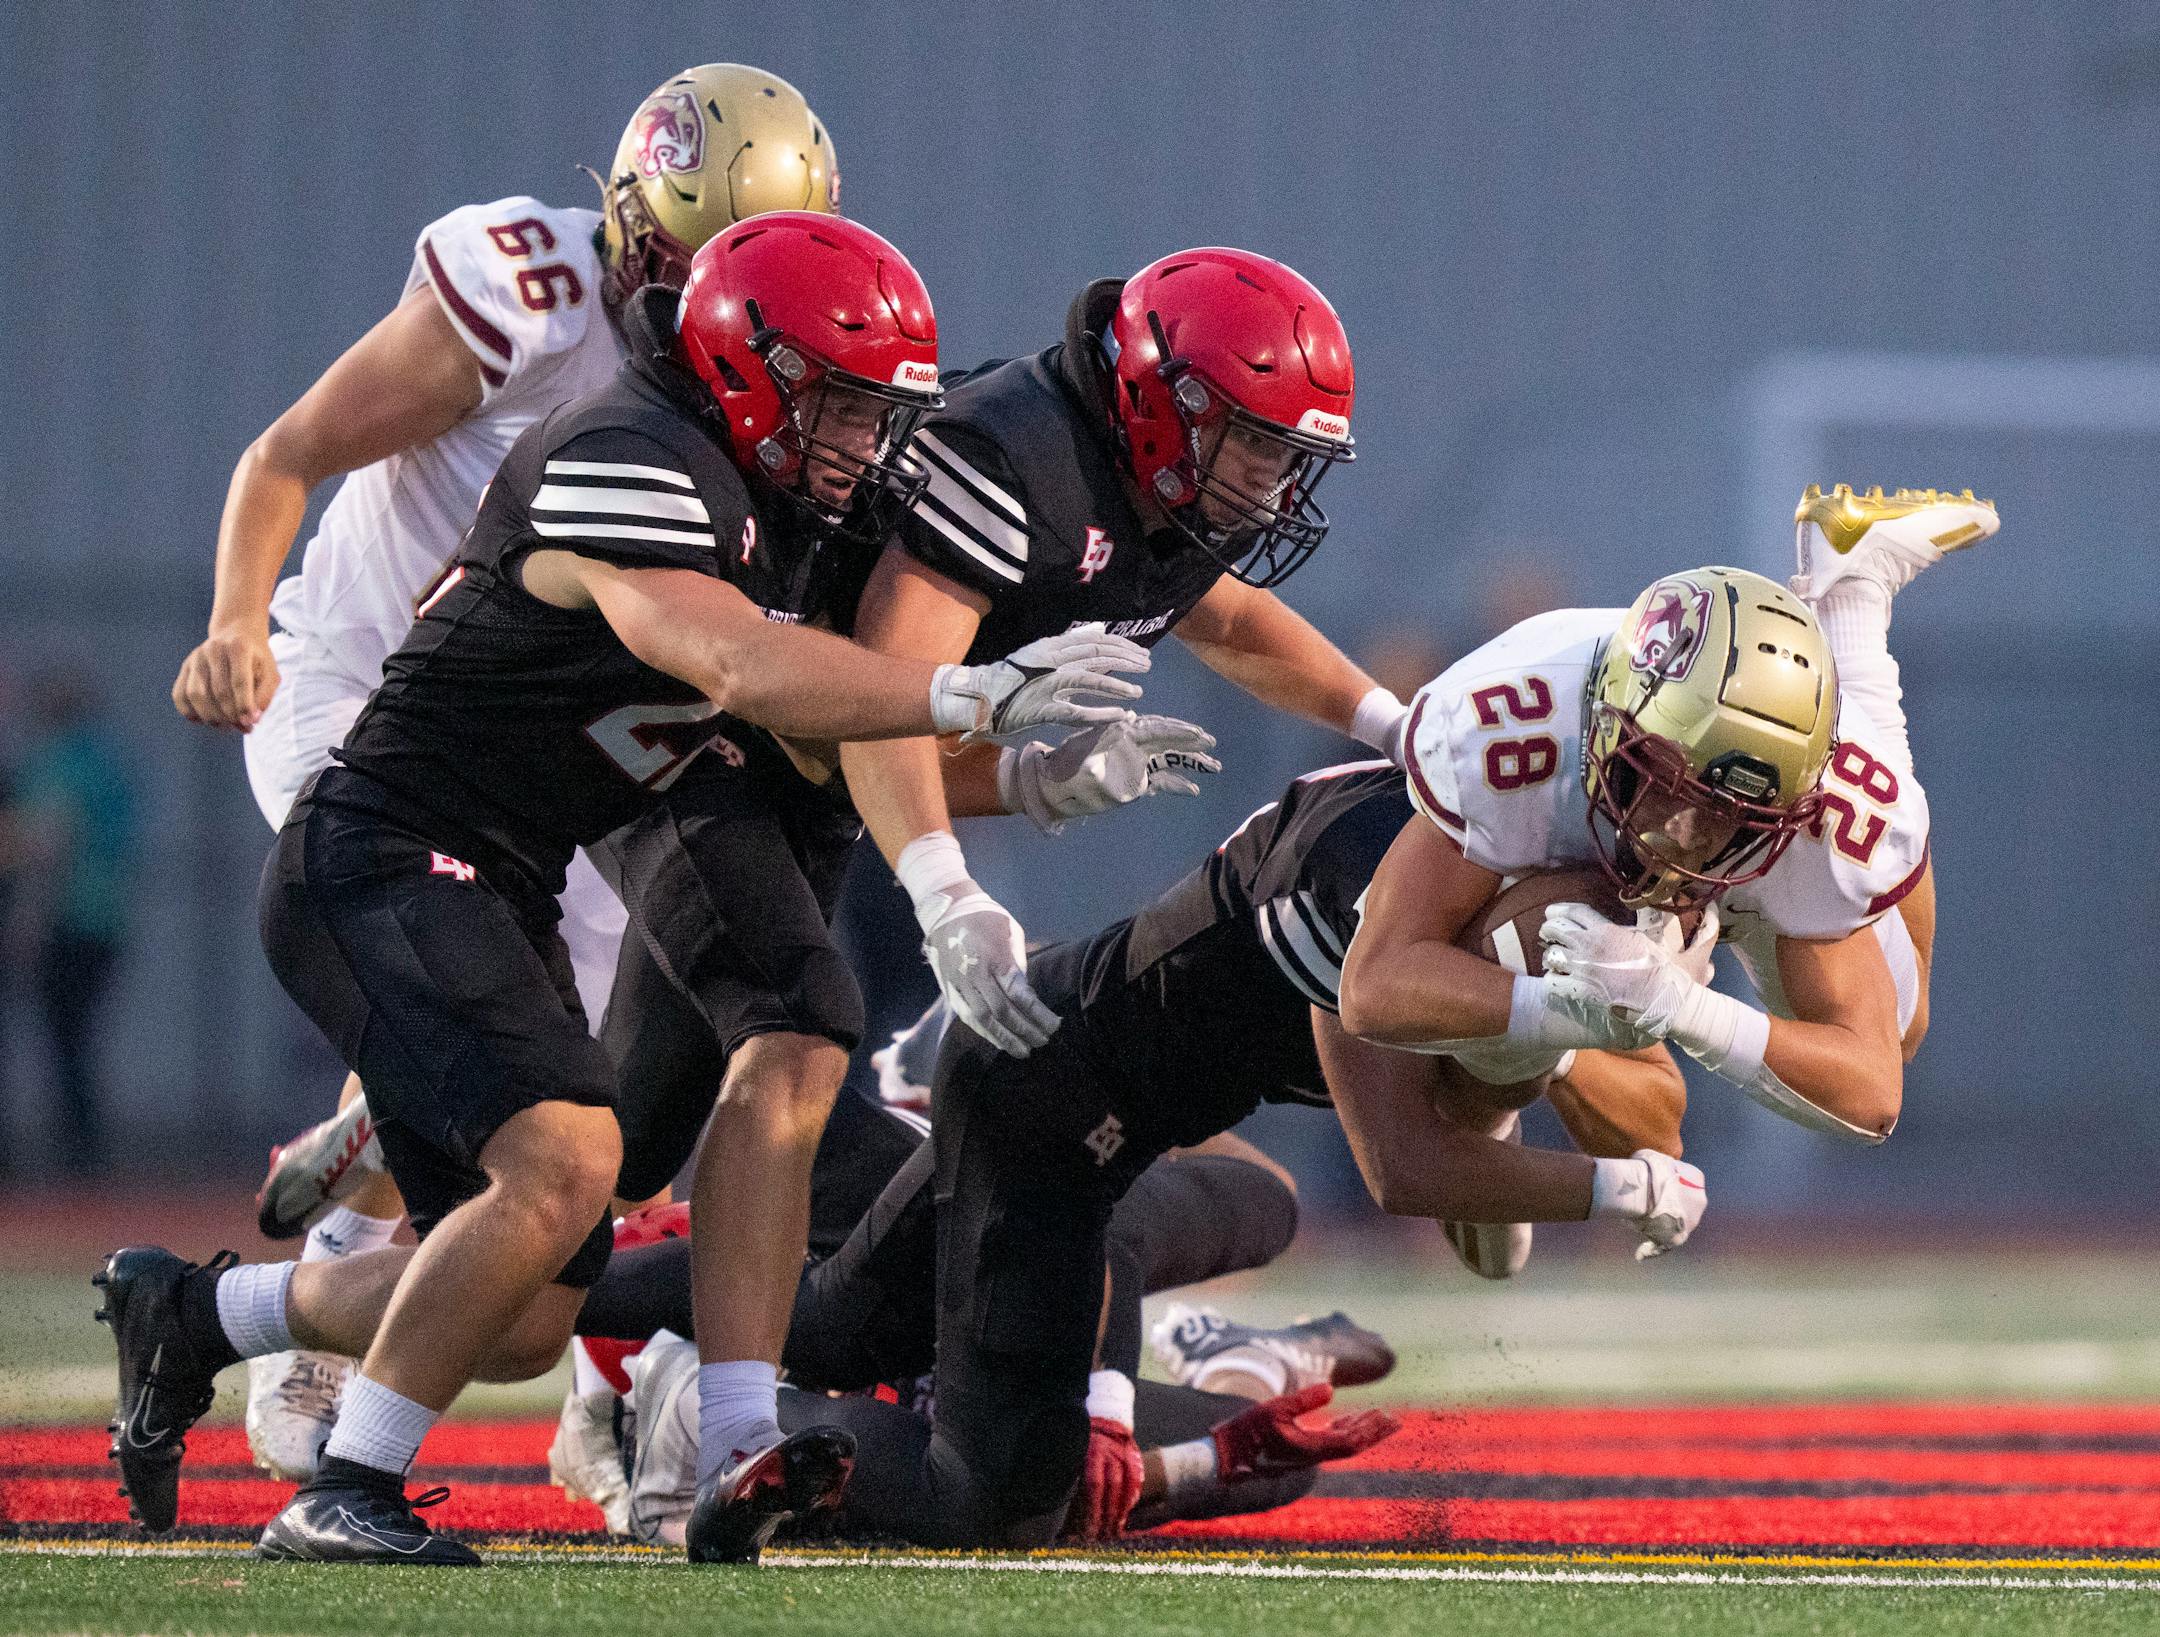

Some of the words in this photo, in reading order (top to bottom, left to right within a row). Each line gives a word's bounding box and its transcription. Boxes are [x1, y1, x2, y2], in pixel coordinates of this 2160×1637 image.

[486, 217, 584, 313] 66
[1471, 675, 1560, 793] 28
[1809, 740, 1901, 870] 28
